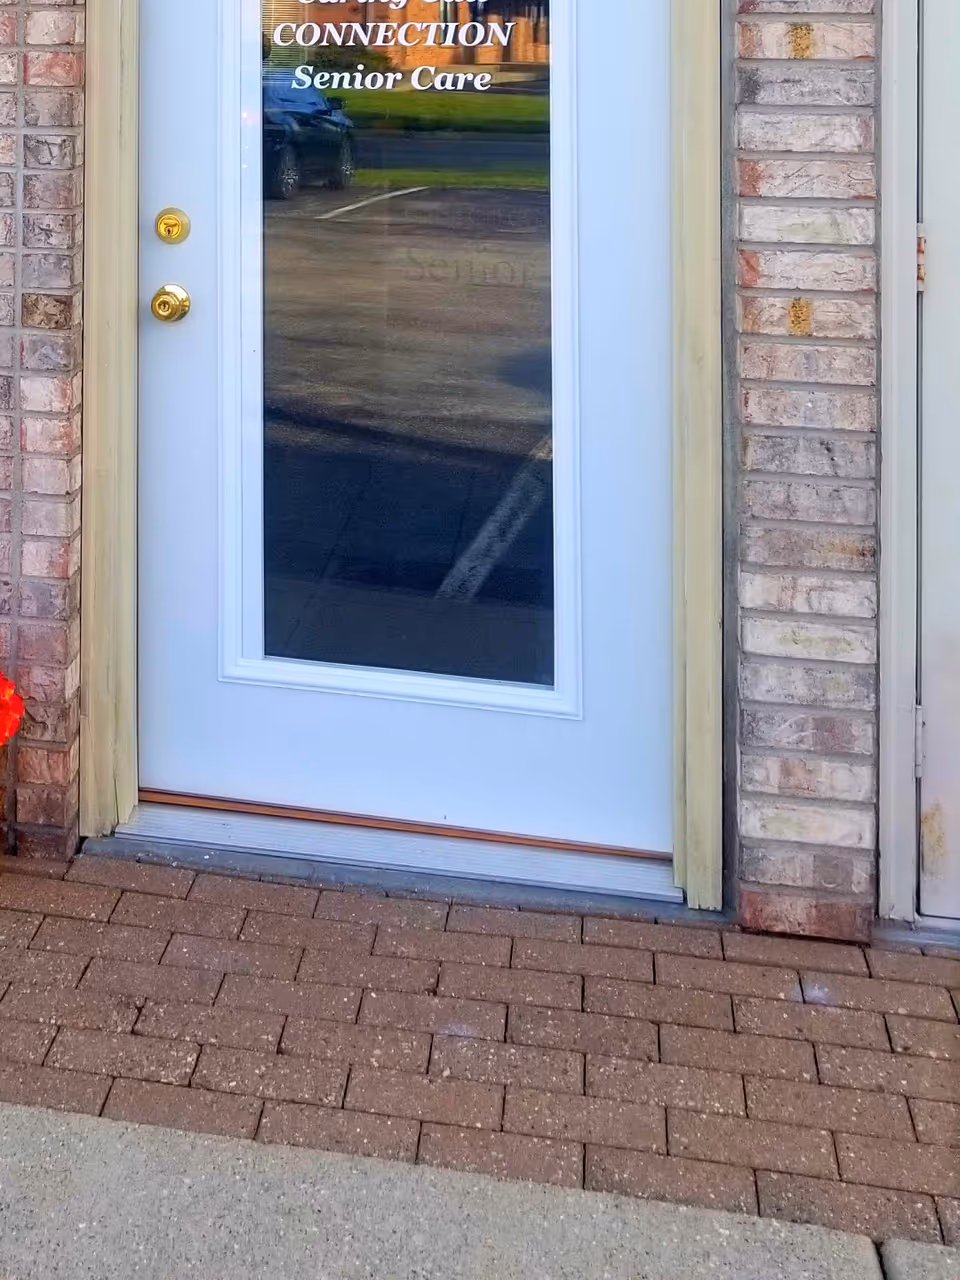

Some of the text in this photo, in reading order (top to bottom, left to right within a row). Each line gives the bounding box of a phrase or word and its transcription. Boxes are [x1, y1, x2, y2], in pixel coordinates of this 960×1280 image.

[272, 22, 517, 47] CONNECTION
[291, 64, 492, 91] Senior Care
